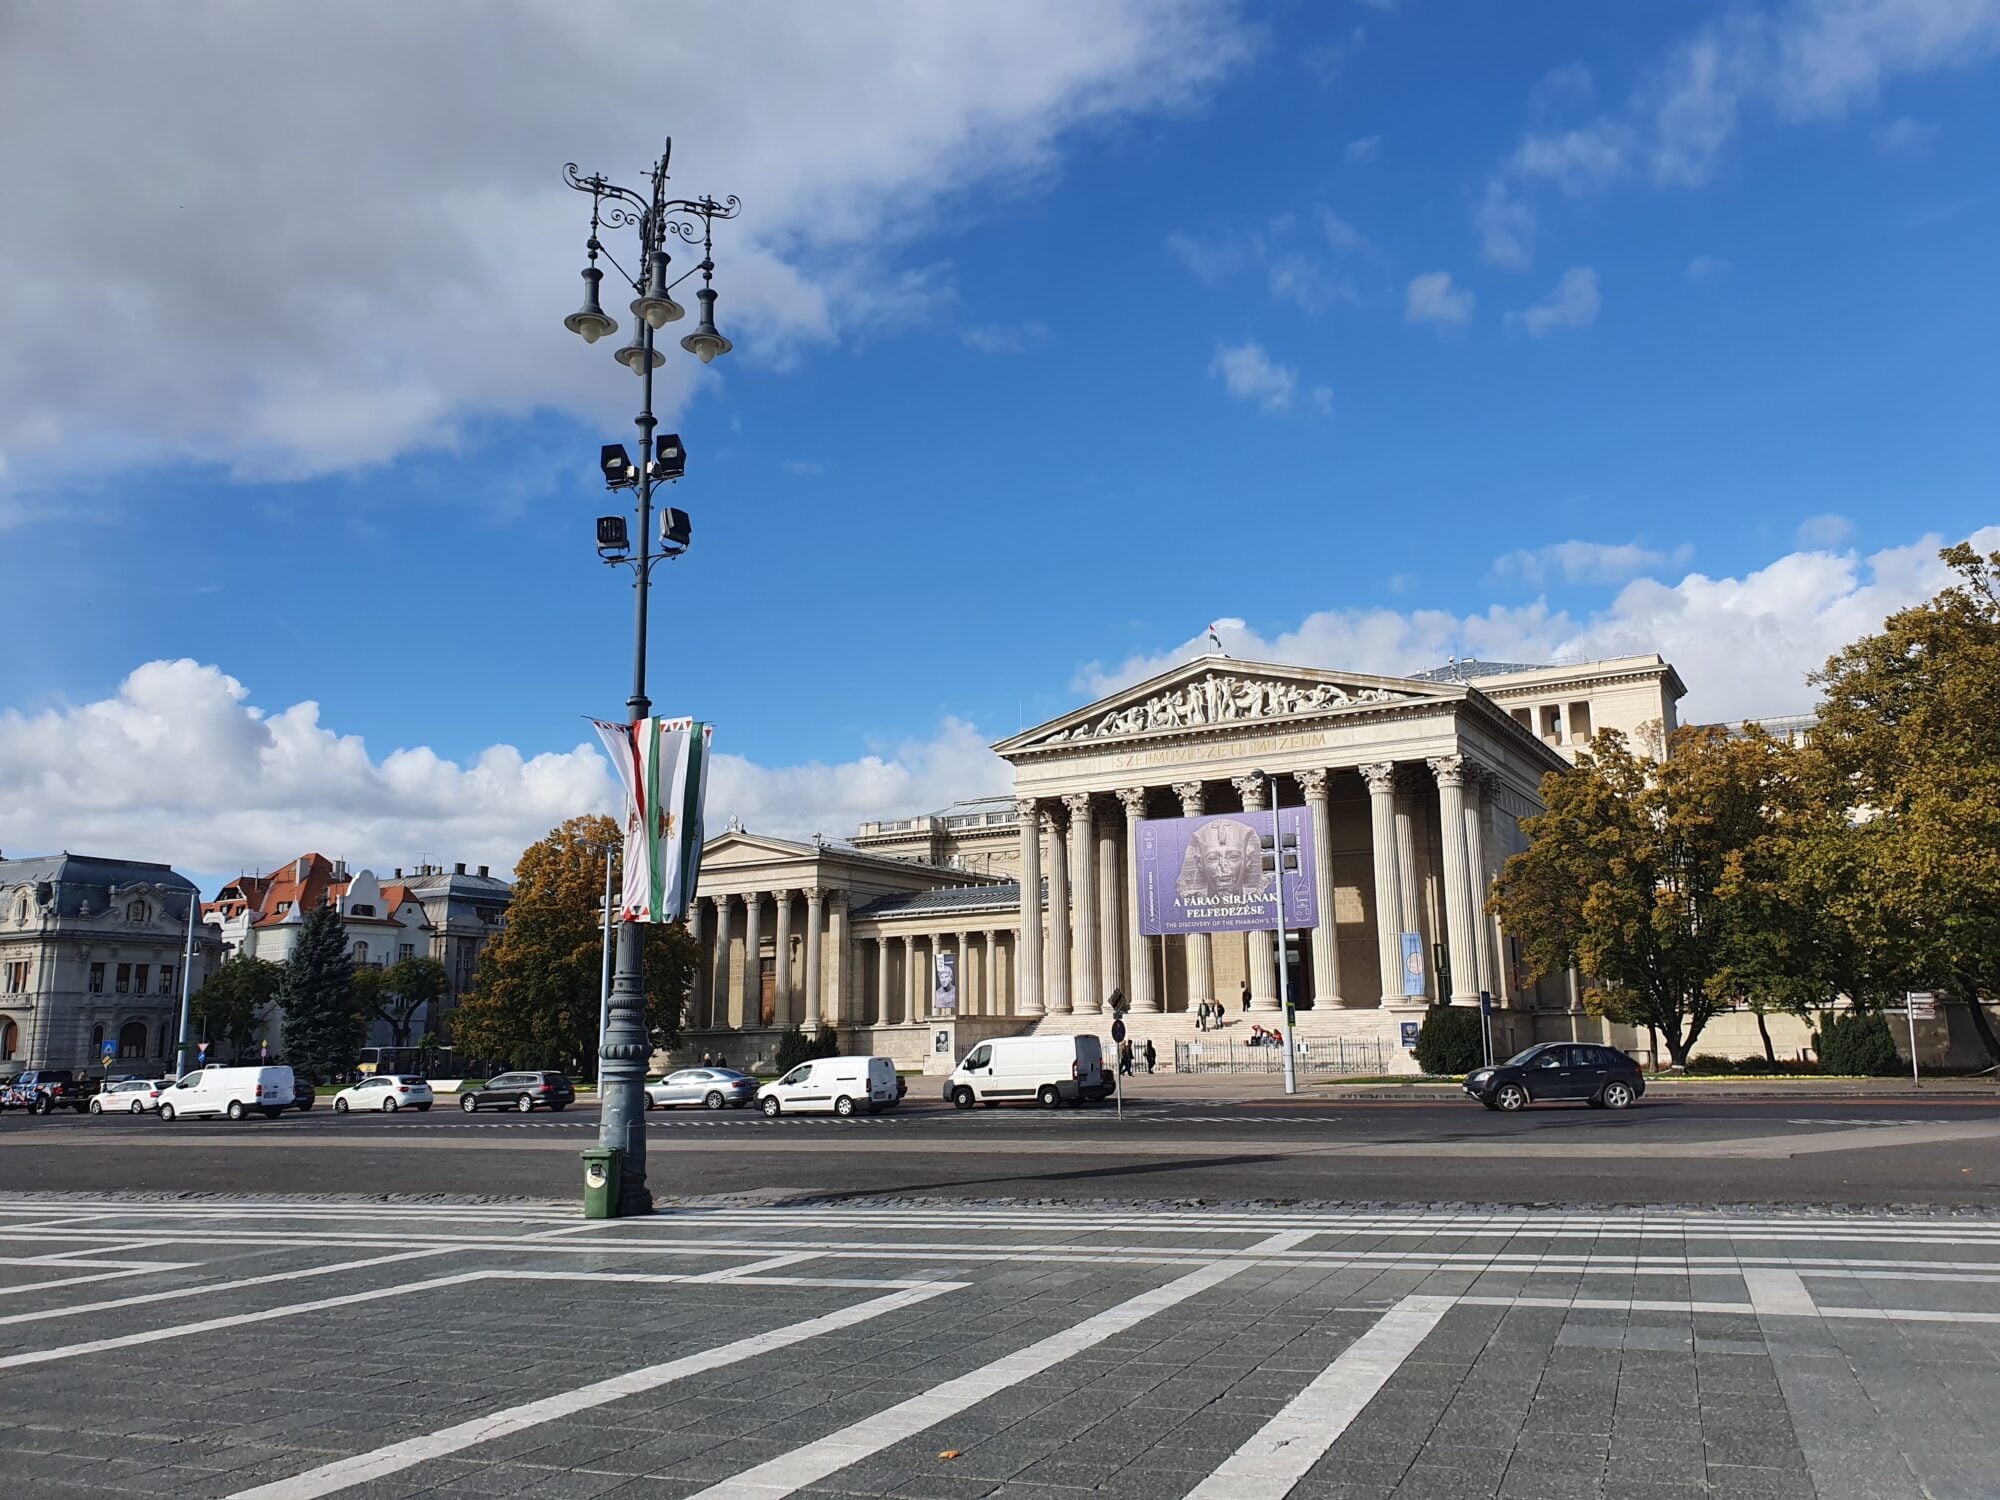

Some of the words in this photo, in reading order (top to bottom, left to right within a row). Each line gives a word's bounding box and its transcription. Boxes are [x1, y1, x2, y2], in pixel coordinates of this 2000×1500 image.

[1173, 898, 1181, 907] A
[1184, 894, 1220, 907] FÁRAÓ
[1222, 892, 1278, 905] SÍRJÁNAK
[1186, 905, 1265, 918] FELFEDEZÉSE
